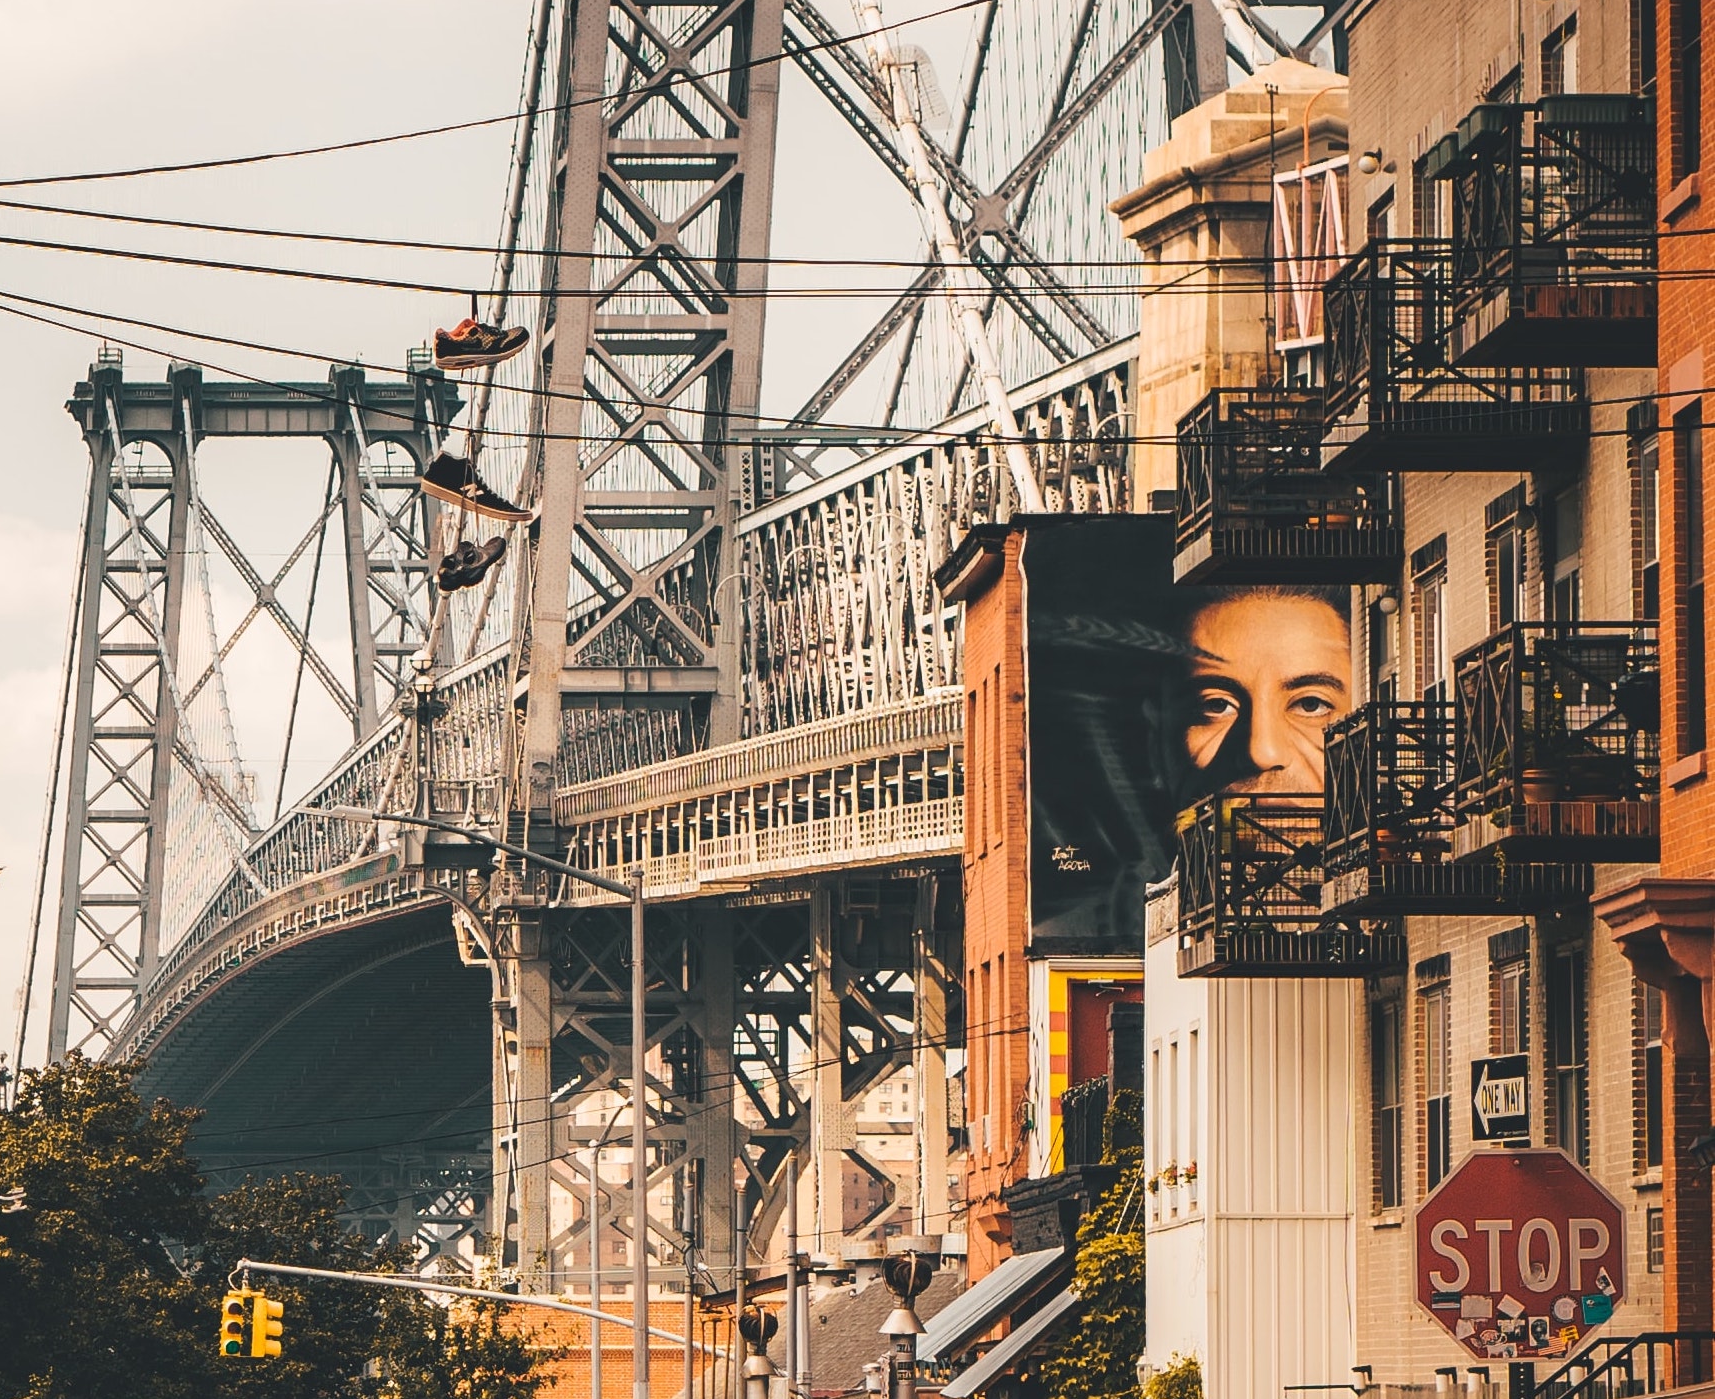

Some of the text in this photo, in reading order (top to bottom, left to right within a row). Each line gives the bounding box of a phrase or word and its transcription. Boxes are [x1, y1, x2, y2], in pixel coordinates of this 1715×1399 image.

[1482, 1081, 1521, 1115] ONE WAY
[1429, 1217, 1611, 1293] STOP
